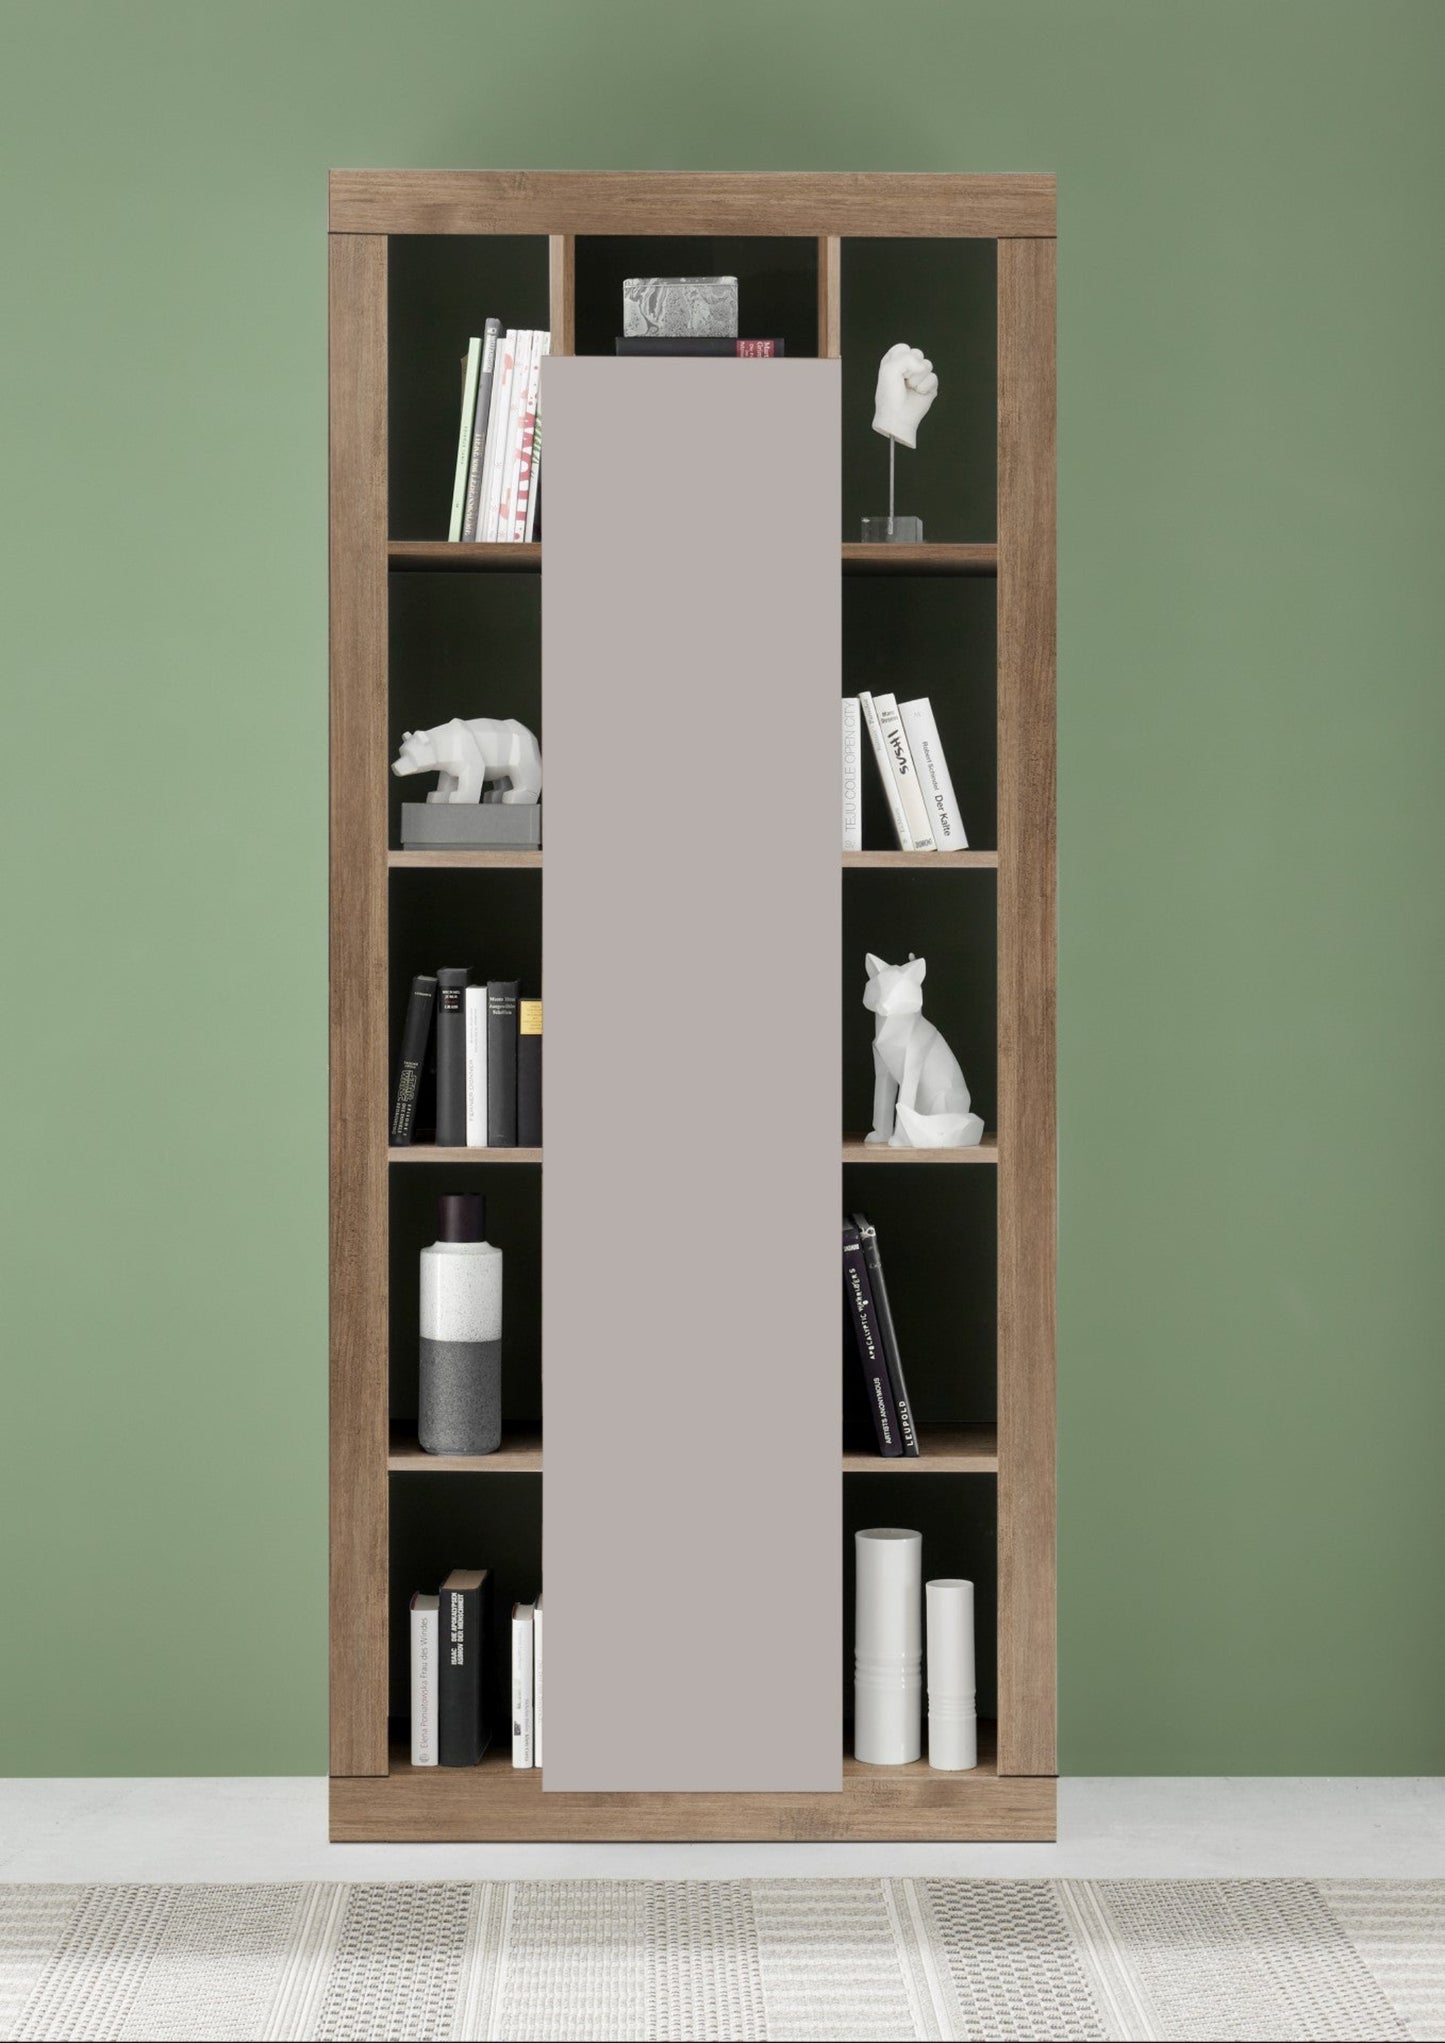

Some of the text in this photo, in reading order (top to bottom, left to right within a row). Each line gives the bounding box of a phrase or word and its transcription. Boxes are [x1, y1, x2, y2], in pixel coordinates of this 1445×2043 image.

[845, 701, 857, 728] CITY
[845, 730, 857, 764] OPEN
[887, 729, 910, 775] SUSHI
[845, 767, 857, 800] COLE
[922, 741, 952, 837] Robert Schindel Der Kalte
[845, 803, 857, 832] TEJU
[860, 1313, 876, 1360] APOCALYPTIC
[873, 1377, 887, 1418] ANONYMOUS
[881, 1418, 892, 1445] ARTISTS
[899, 1400, 914, 1447] LEUPOLD
[419, 1617, 429, 1749] Elena Poniatowska Frau des Windes
